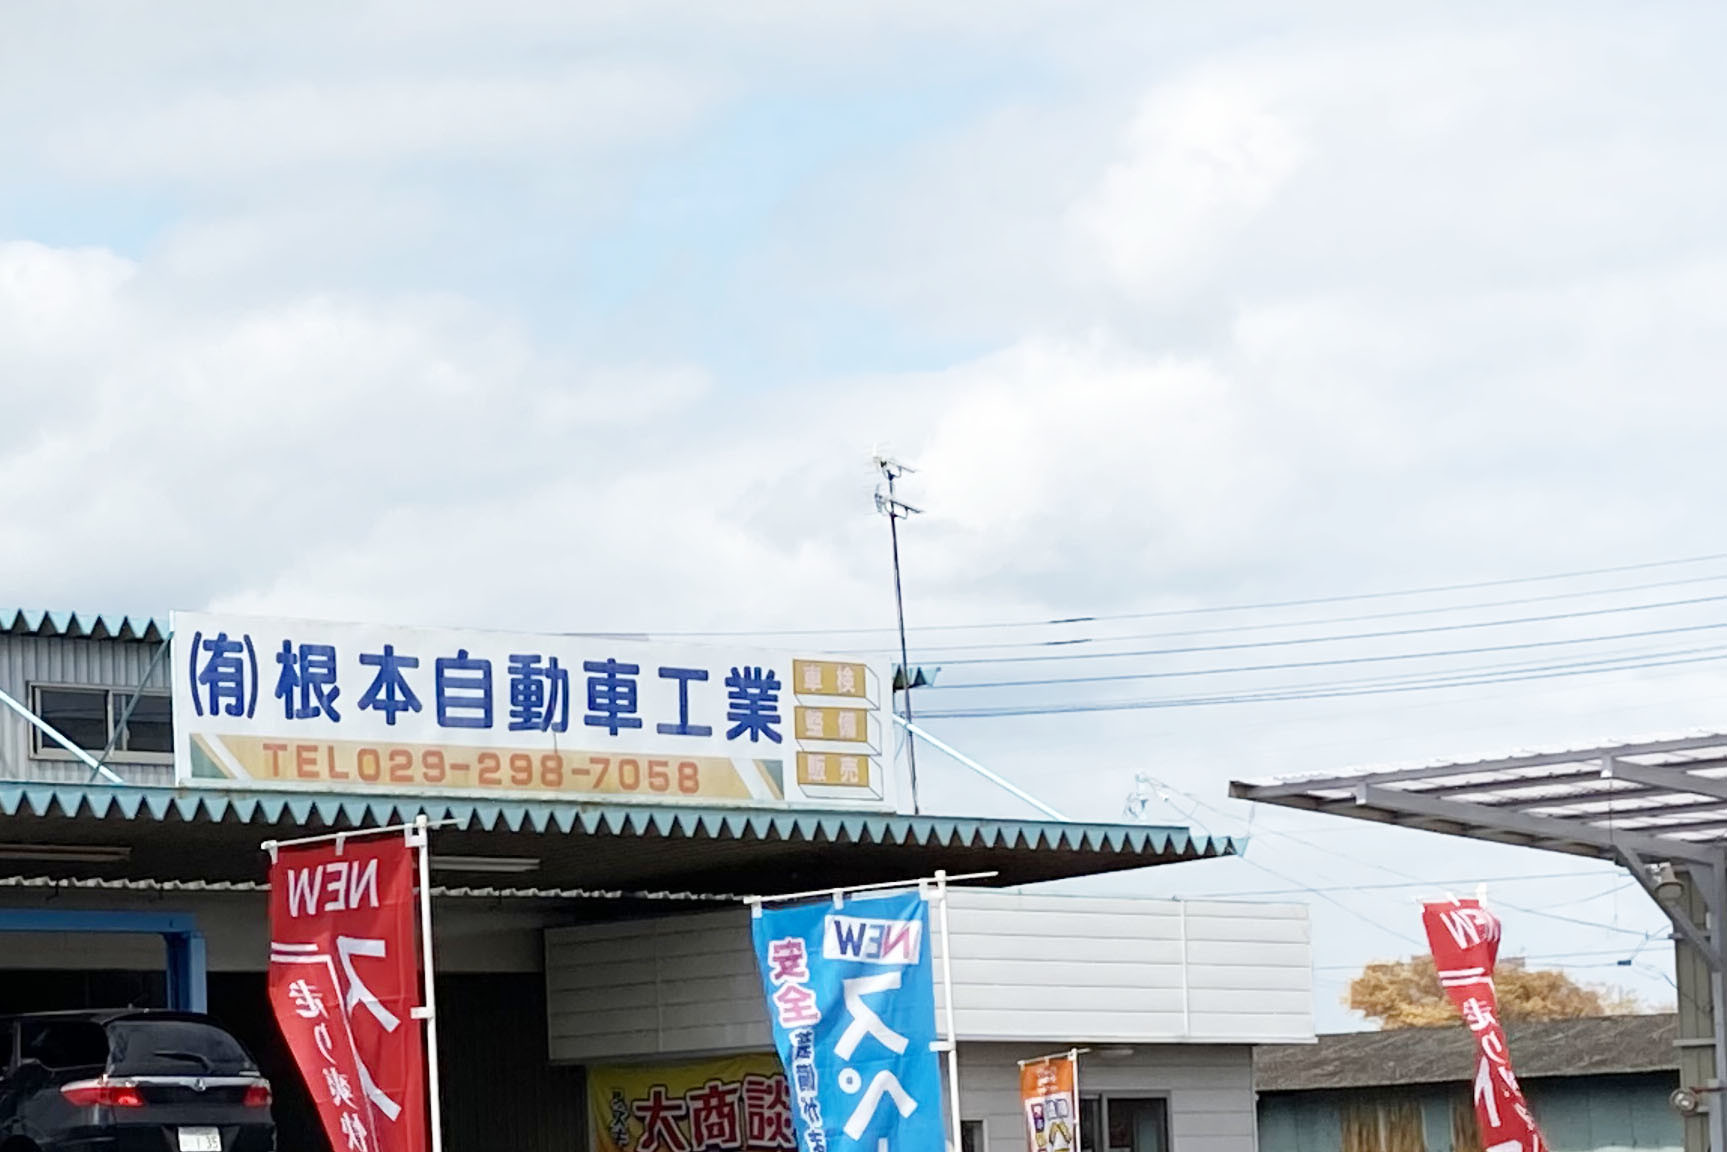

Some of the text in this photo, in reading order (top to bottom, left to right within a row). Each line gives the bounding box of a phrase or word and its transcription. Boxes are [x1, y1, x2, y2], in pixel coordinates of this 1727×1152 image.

[189, 631, 783, 744] (有)根本自動車工業
